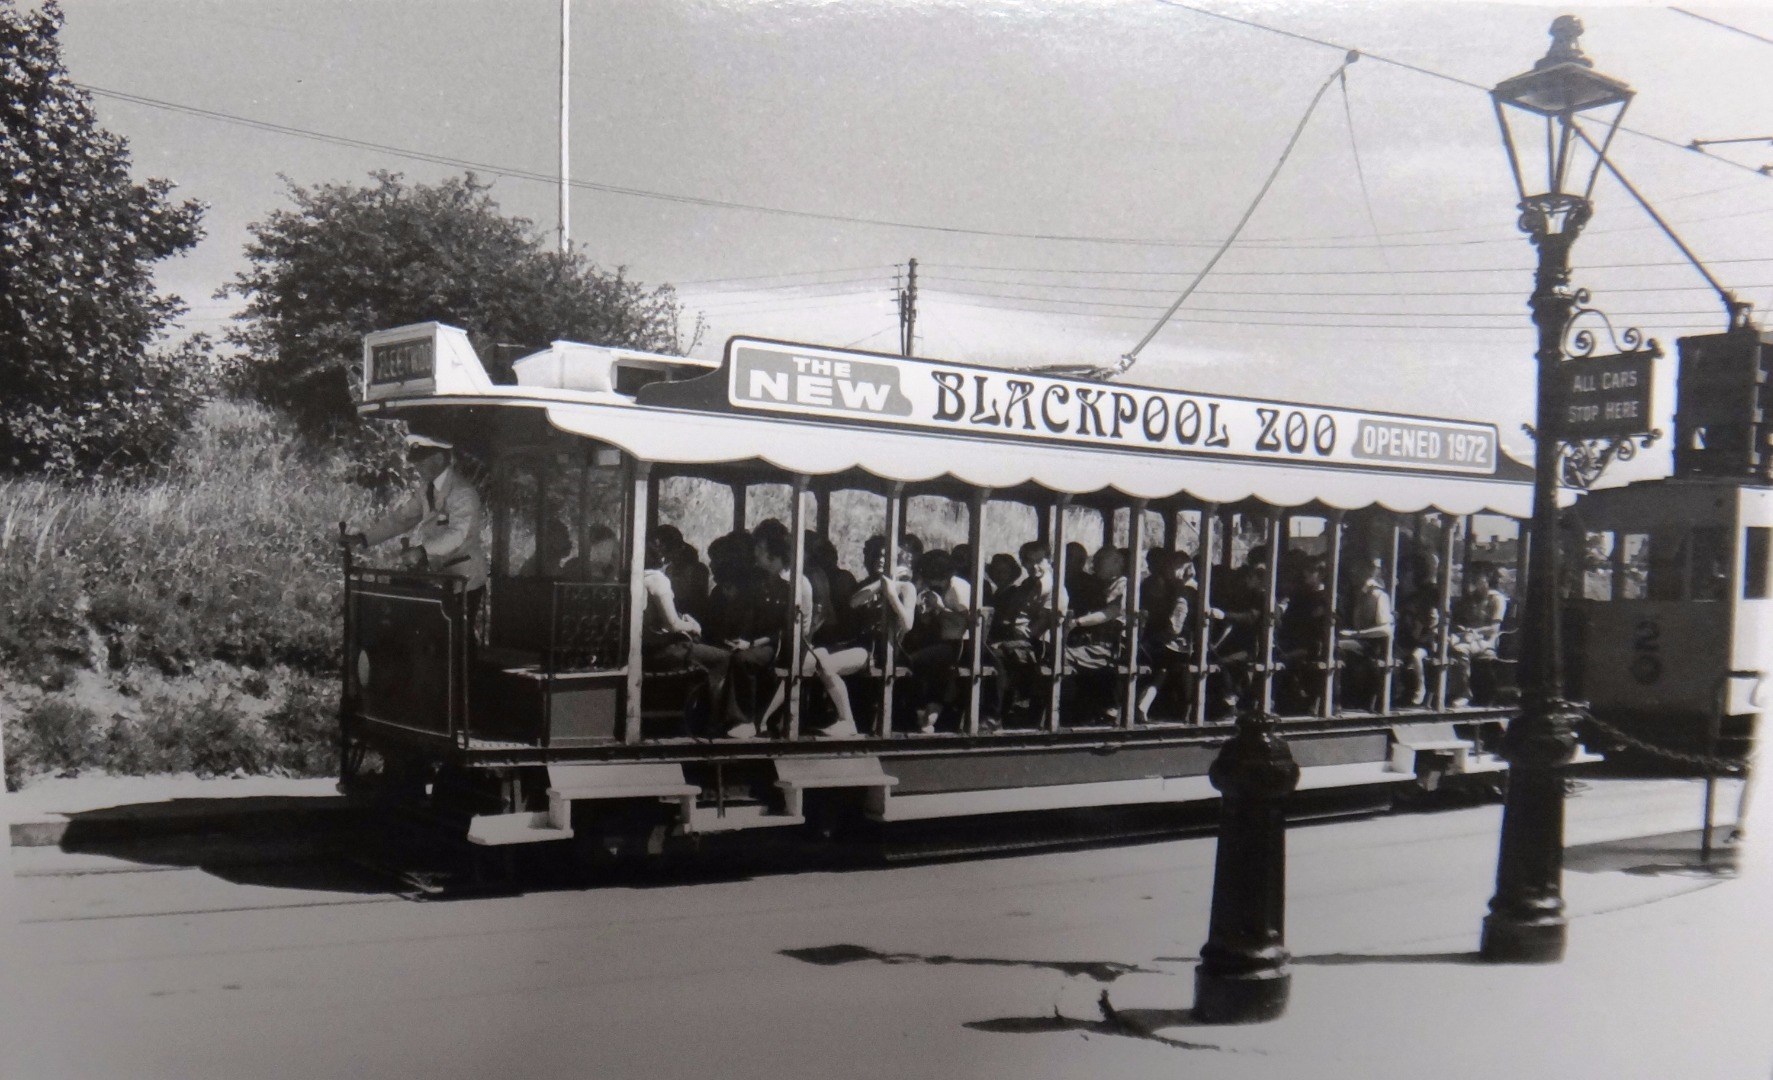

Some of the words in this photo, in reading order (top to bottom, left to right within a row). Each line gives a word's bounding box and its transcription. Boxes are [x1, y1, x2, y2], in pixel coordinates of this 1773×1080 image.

[792, 356, 851, 378] THE
[1572, 374, 1597, 393] ALL
[1602, 370, 1638, 390] CARS
[750, 369, 891, 411] NEW
[931, 370, 1230, 448] BLACKPOOL
[1256, 407, 1337, 456] ZOO
[1568, 404, 1599, 423] STOP
[1605, 400, 1639, 420] HERE
[1362, 425, 1441, 459] OPENED
[1447, 433, 1488, 463] 1972
